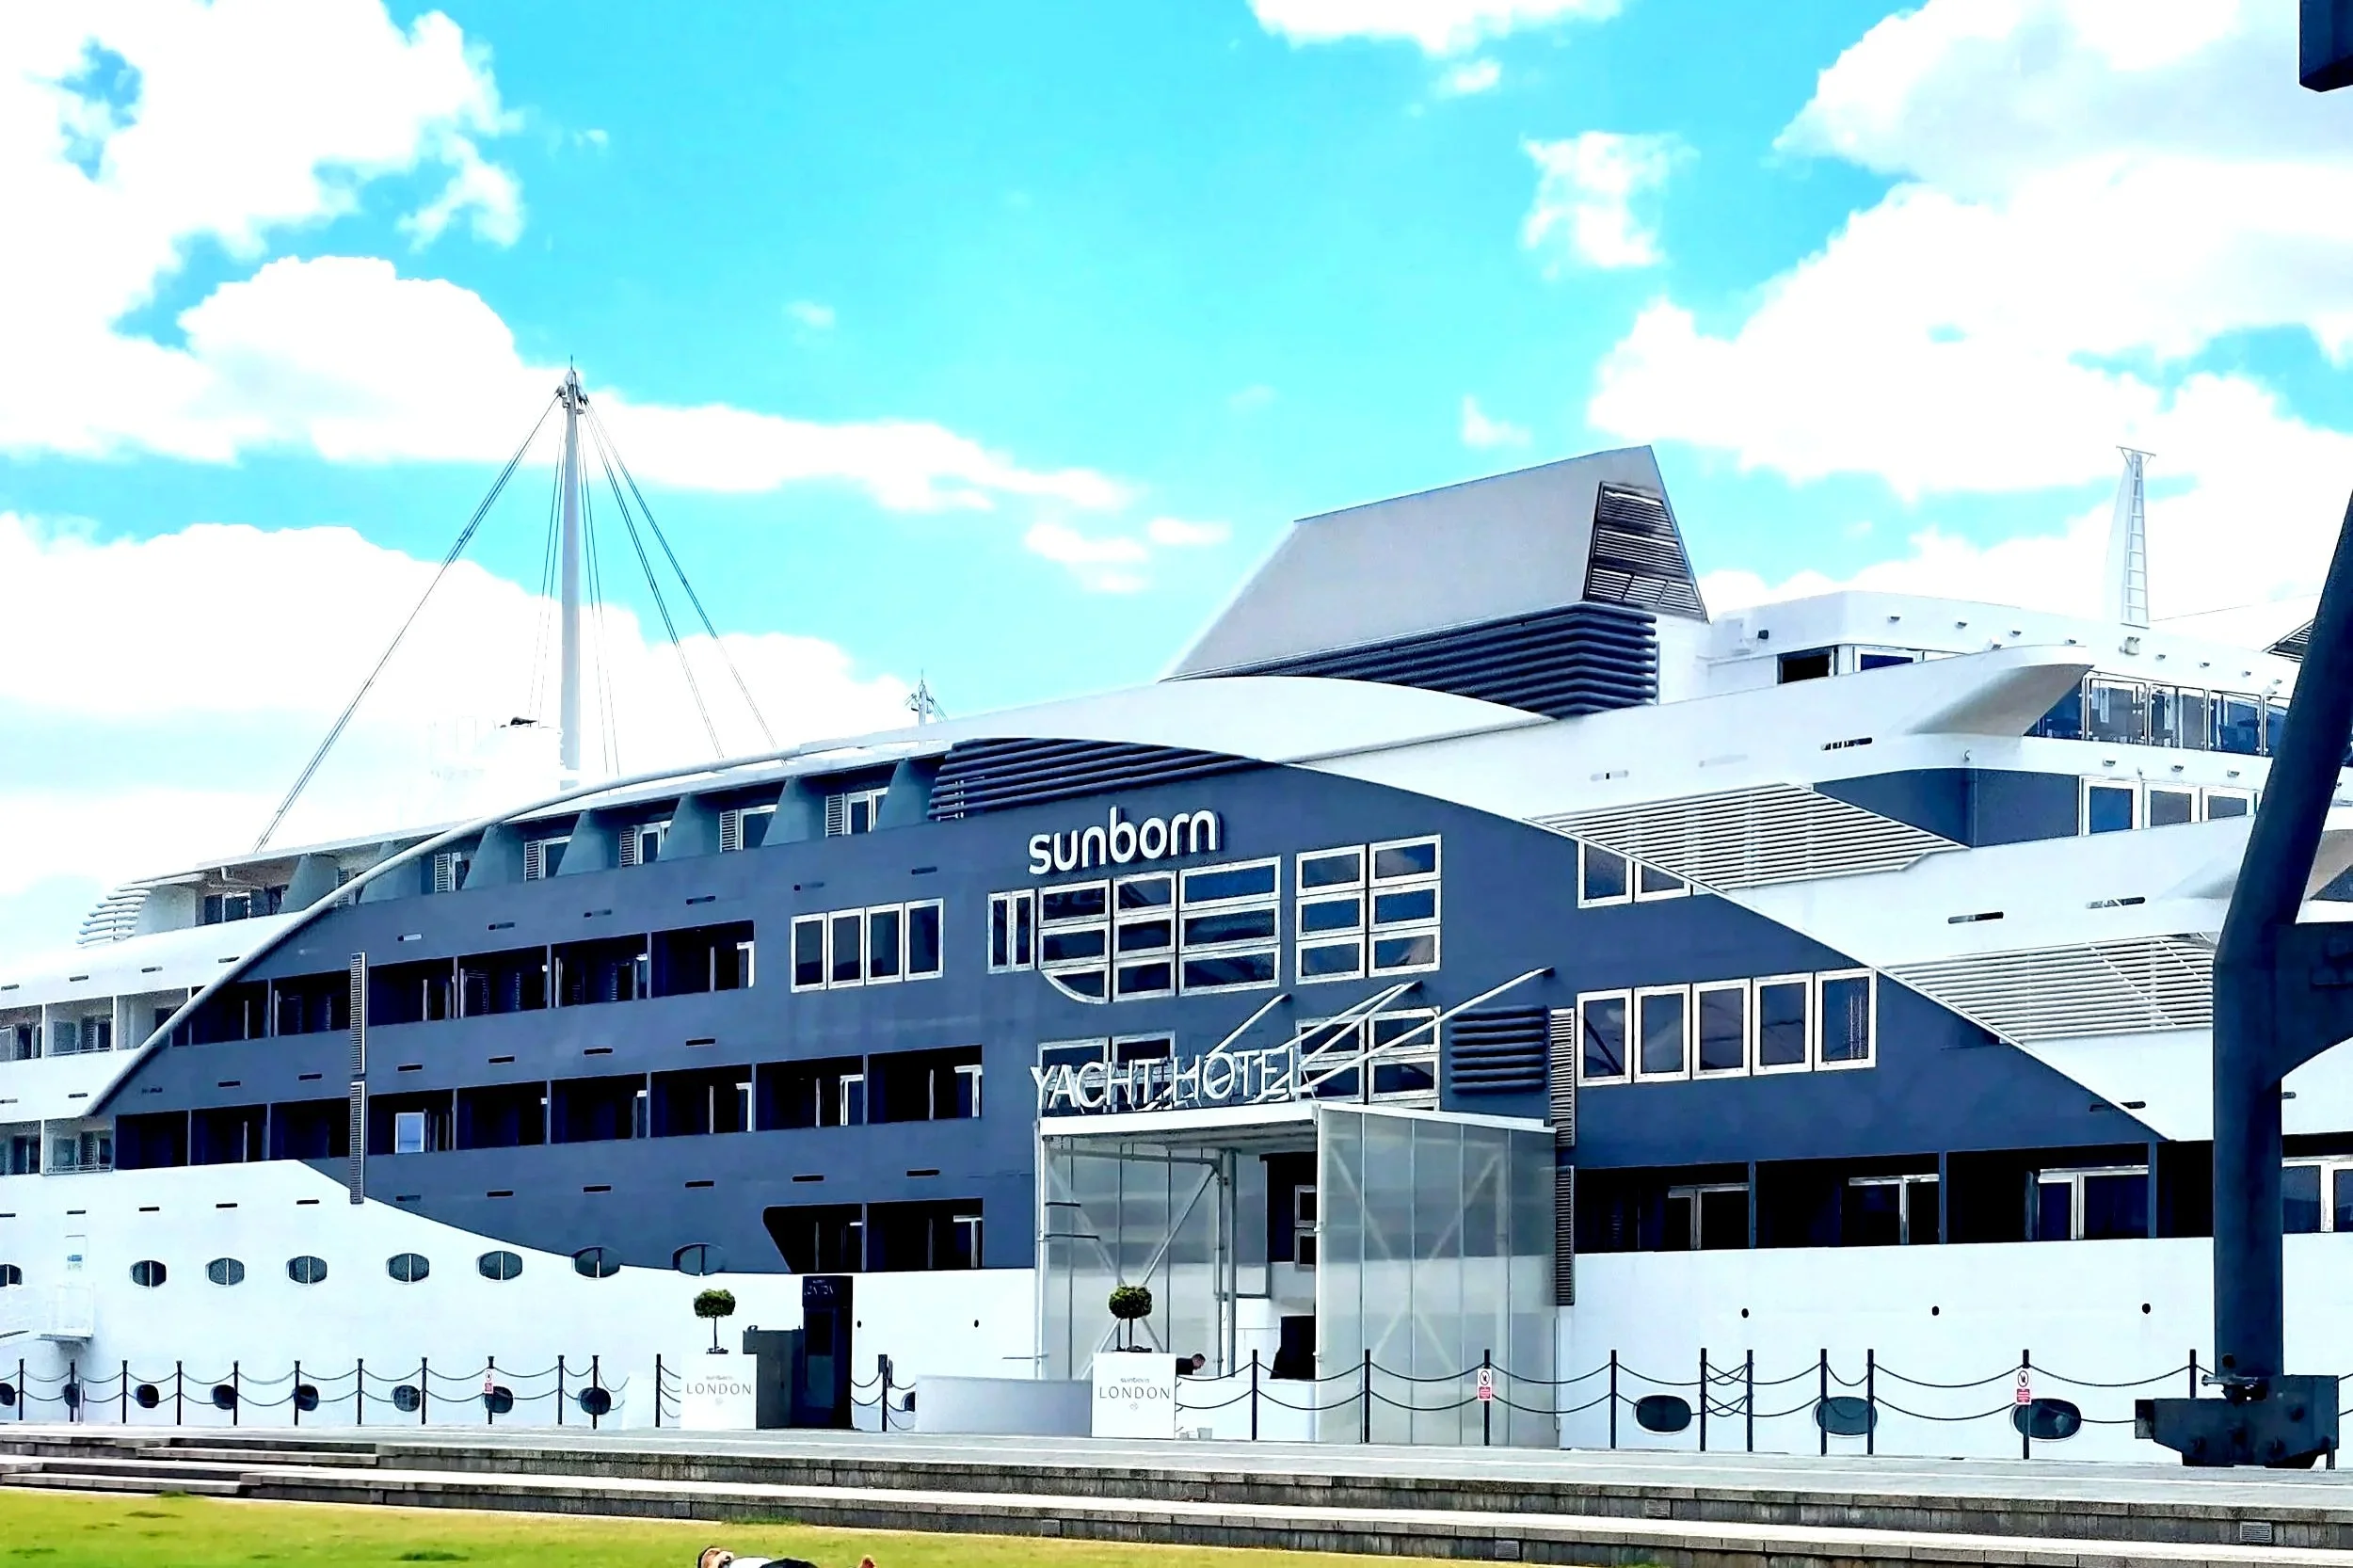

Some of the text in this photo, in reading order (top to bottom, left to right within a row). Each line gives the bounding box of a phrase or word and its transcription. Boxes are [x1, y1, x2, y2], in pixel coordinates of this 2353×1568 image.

[1029, 806, 1216, 874] sunborn
[1030, 1047, 1309, 1110] YACHT HOTEL
[686, 1383, 752, 1395] LONDON
[1099, 1385, 1170, 1399] LONDON
